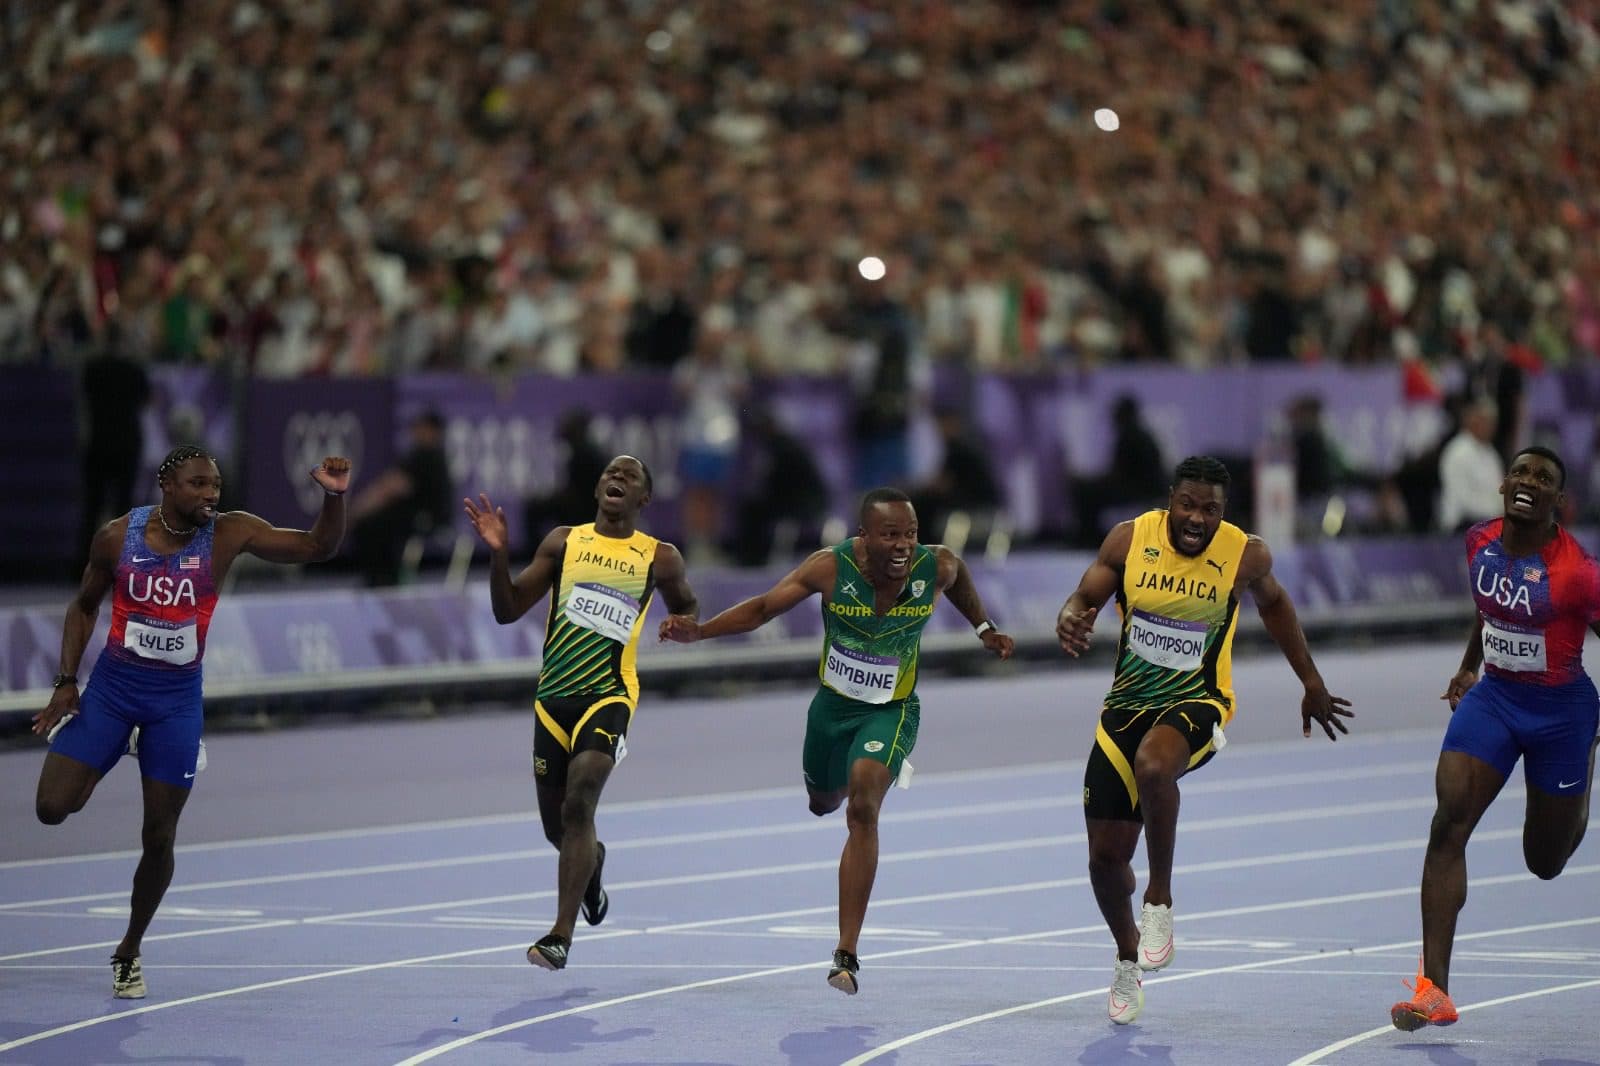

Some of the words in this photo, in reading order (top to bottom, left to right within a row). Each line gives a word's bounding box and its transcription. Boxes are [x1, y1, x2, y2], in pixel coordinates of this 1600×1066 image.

[575, 551, 635, 577] JAMAICA
[128, 572, 196, 607] USA
[1135, 571, 1217, 603] JAMAICA
[1476, 565, 1533, 616] USA
[573, 596, 632, 631] SEVILLE
[828, 602, 872, 617] SOUTH
[886, 602, 934, 617] AFRICA
[139, 632, 185, 652] LYLES
[1132, 624, 1203, 657] THOMPSON
[1484, 631, 1540, 657] KERLEY
[827, 655, 894, 690] SIMBINE
